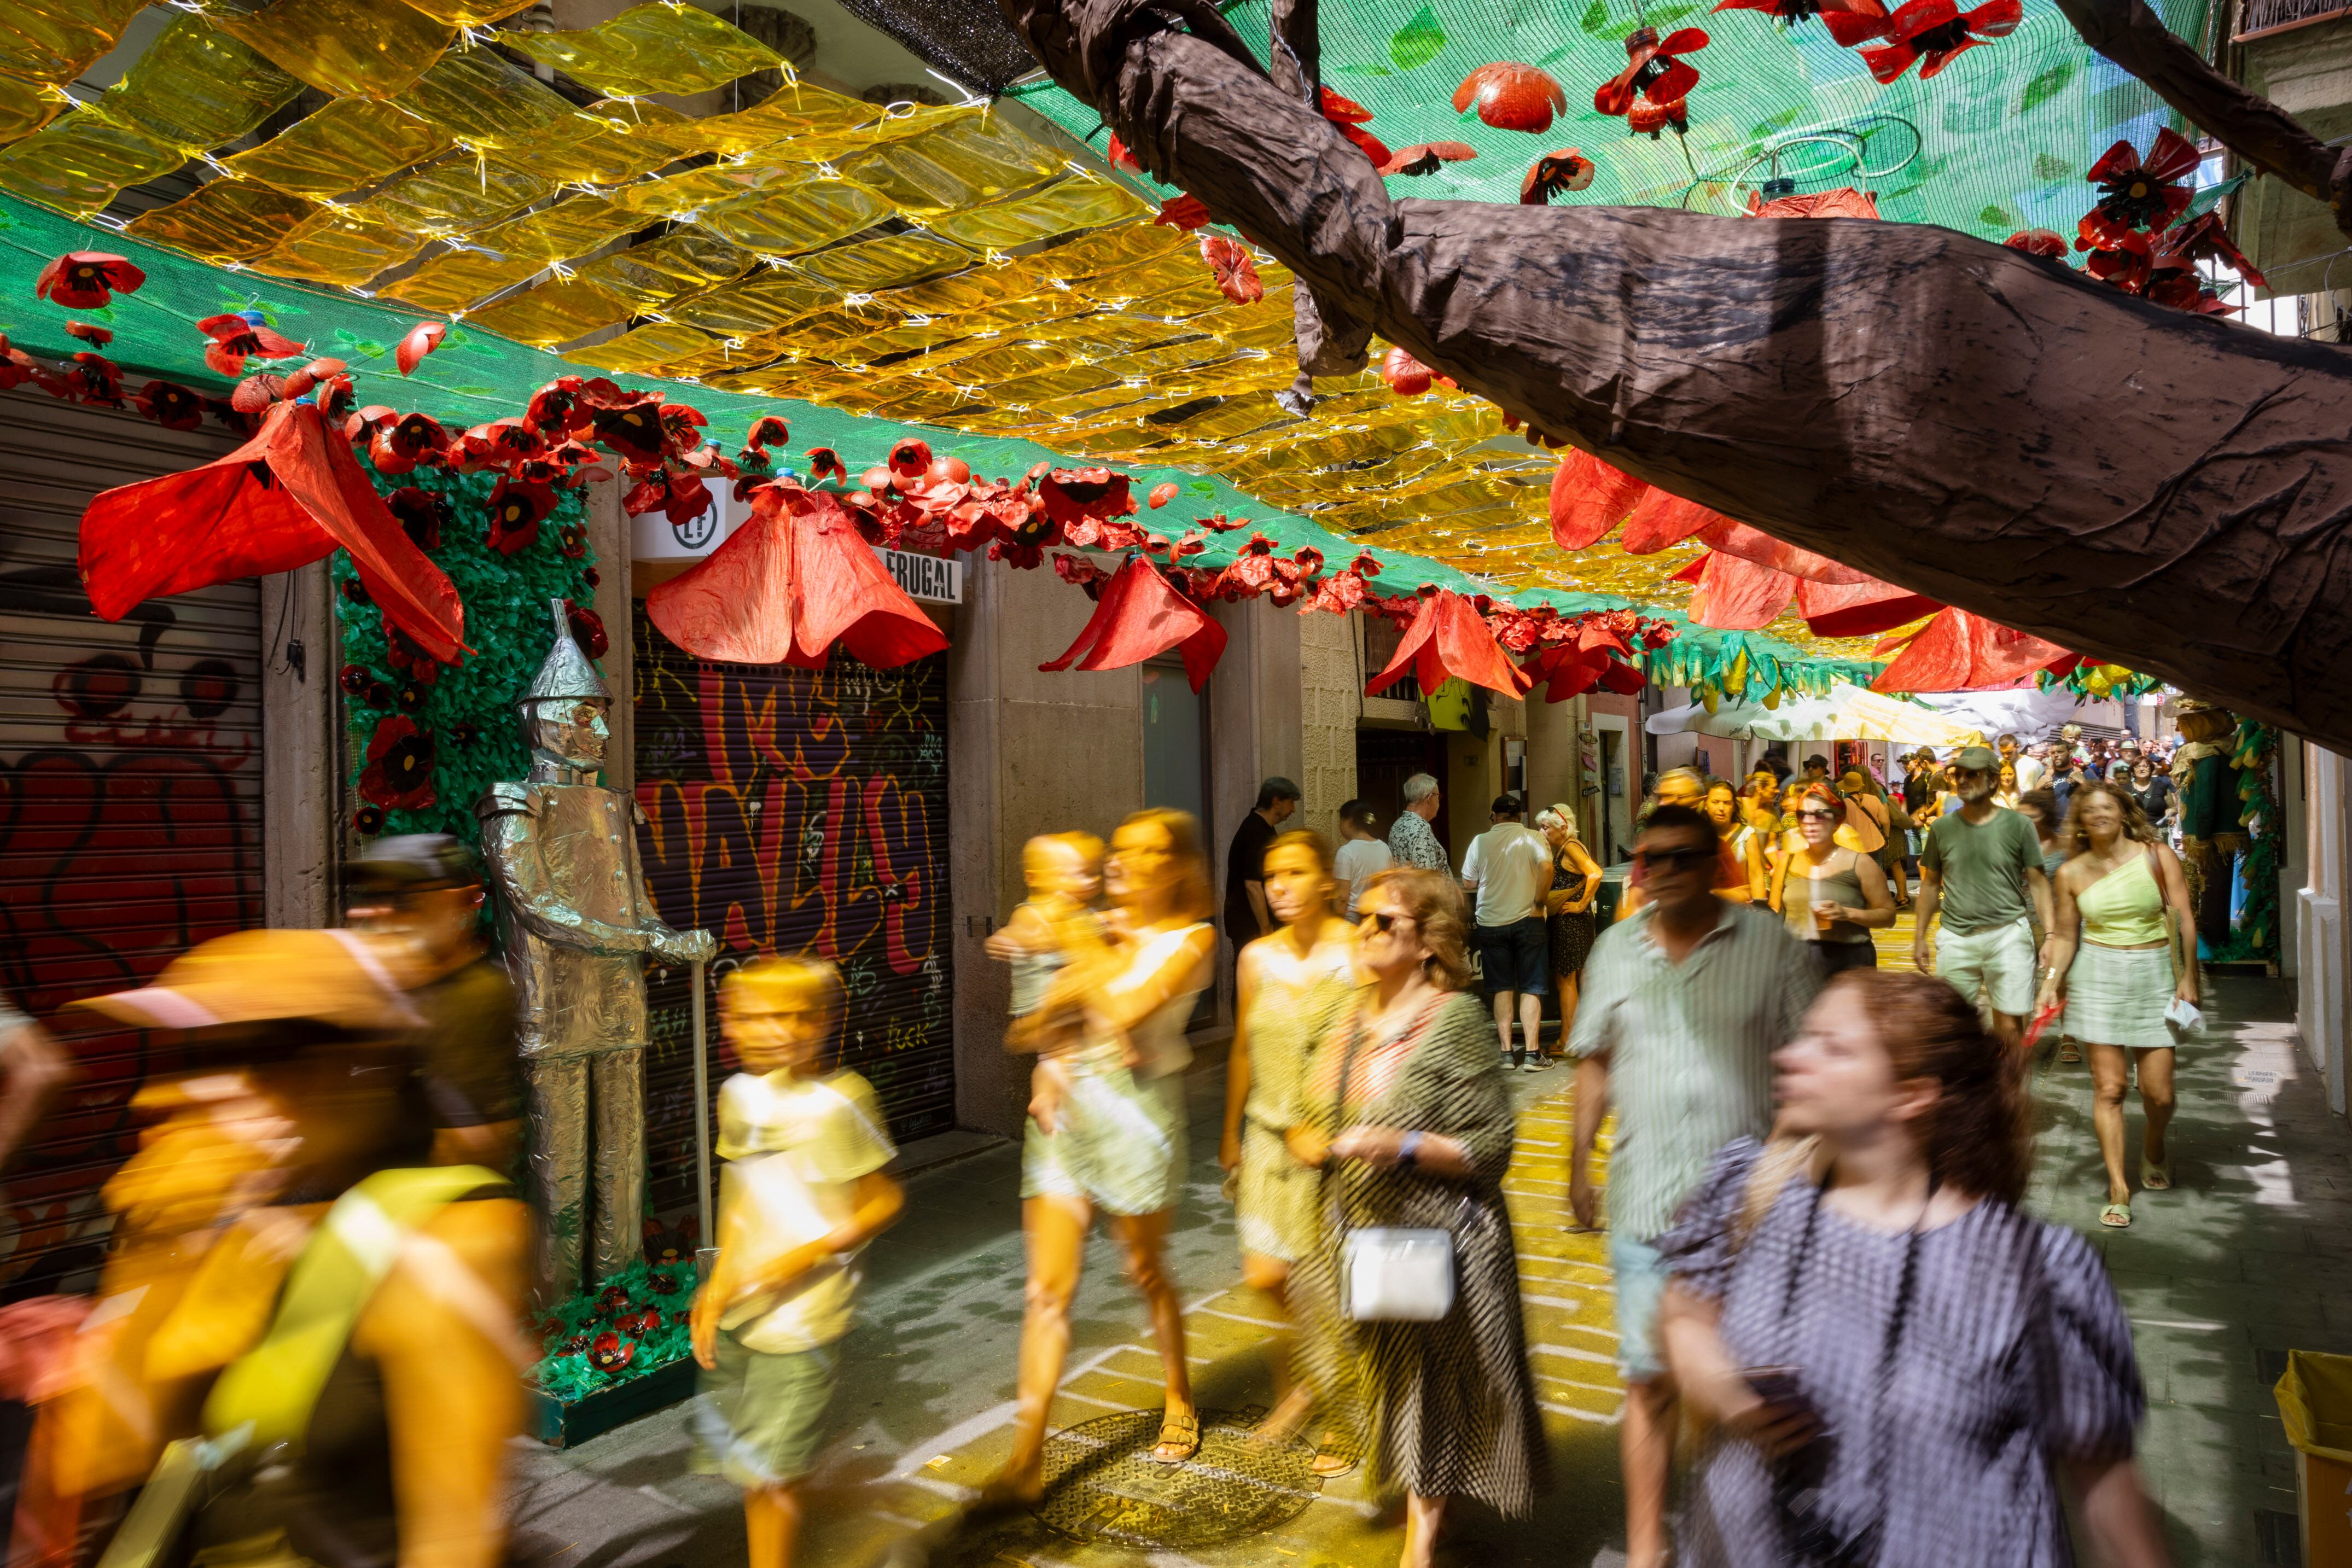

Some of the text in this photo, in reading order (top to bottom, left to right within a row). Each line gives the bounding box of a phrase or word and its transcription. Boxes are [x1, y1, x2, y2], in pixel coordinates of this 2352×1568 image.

[886, 551, 956, 600] FRUGAL
[2053, 778, 2066, 788] OCK
[887, 1016, 930, 1050] FUCK
